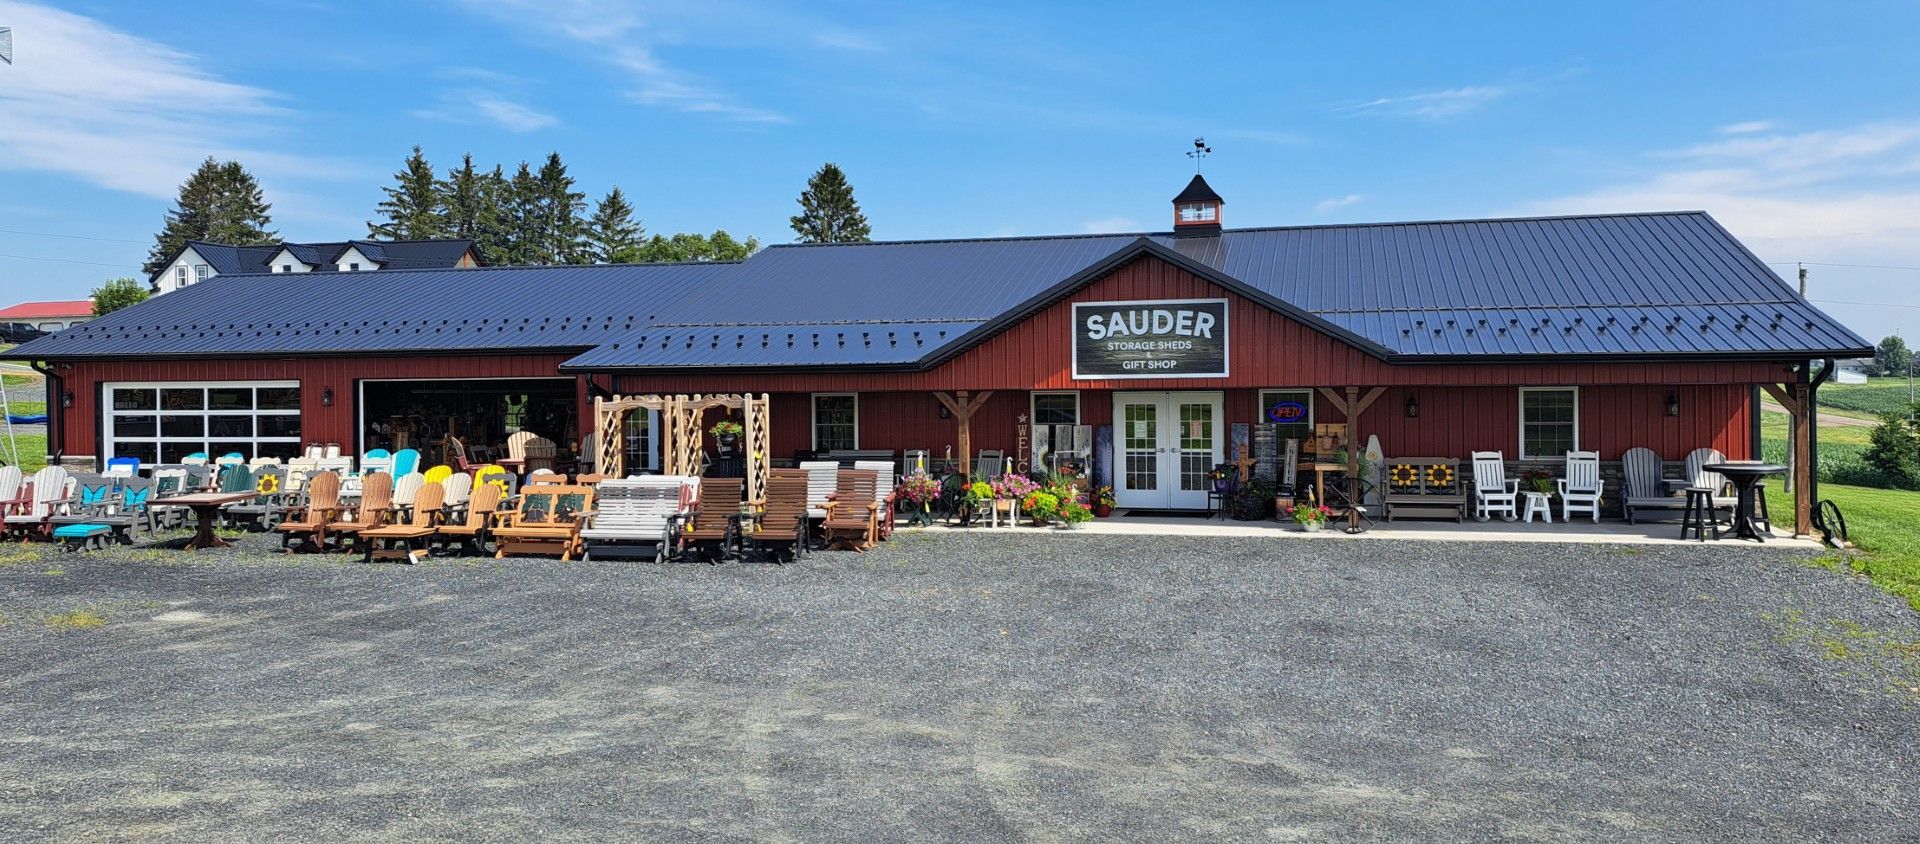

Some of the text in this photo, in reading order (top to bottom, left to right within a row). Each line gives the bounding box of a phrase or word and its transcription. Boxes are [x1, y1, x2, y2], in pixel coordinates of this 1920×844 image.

[1086, 309, 1215, 340] SAUDER
[1107, 340, 1193, 351] STORAGE SHEDS
[1145, 351, 1152, 359] &
[1122, 360, 1177, 370] GIFT SHOP
[1272, 407, 1302, 418] OPEN
[1017, 424, 1028, 474] WELC
